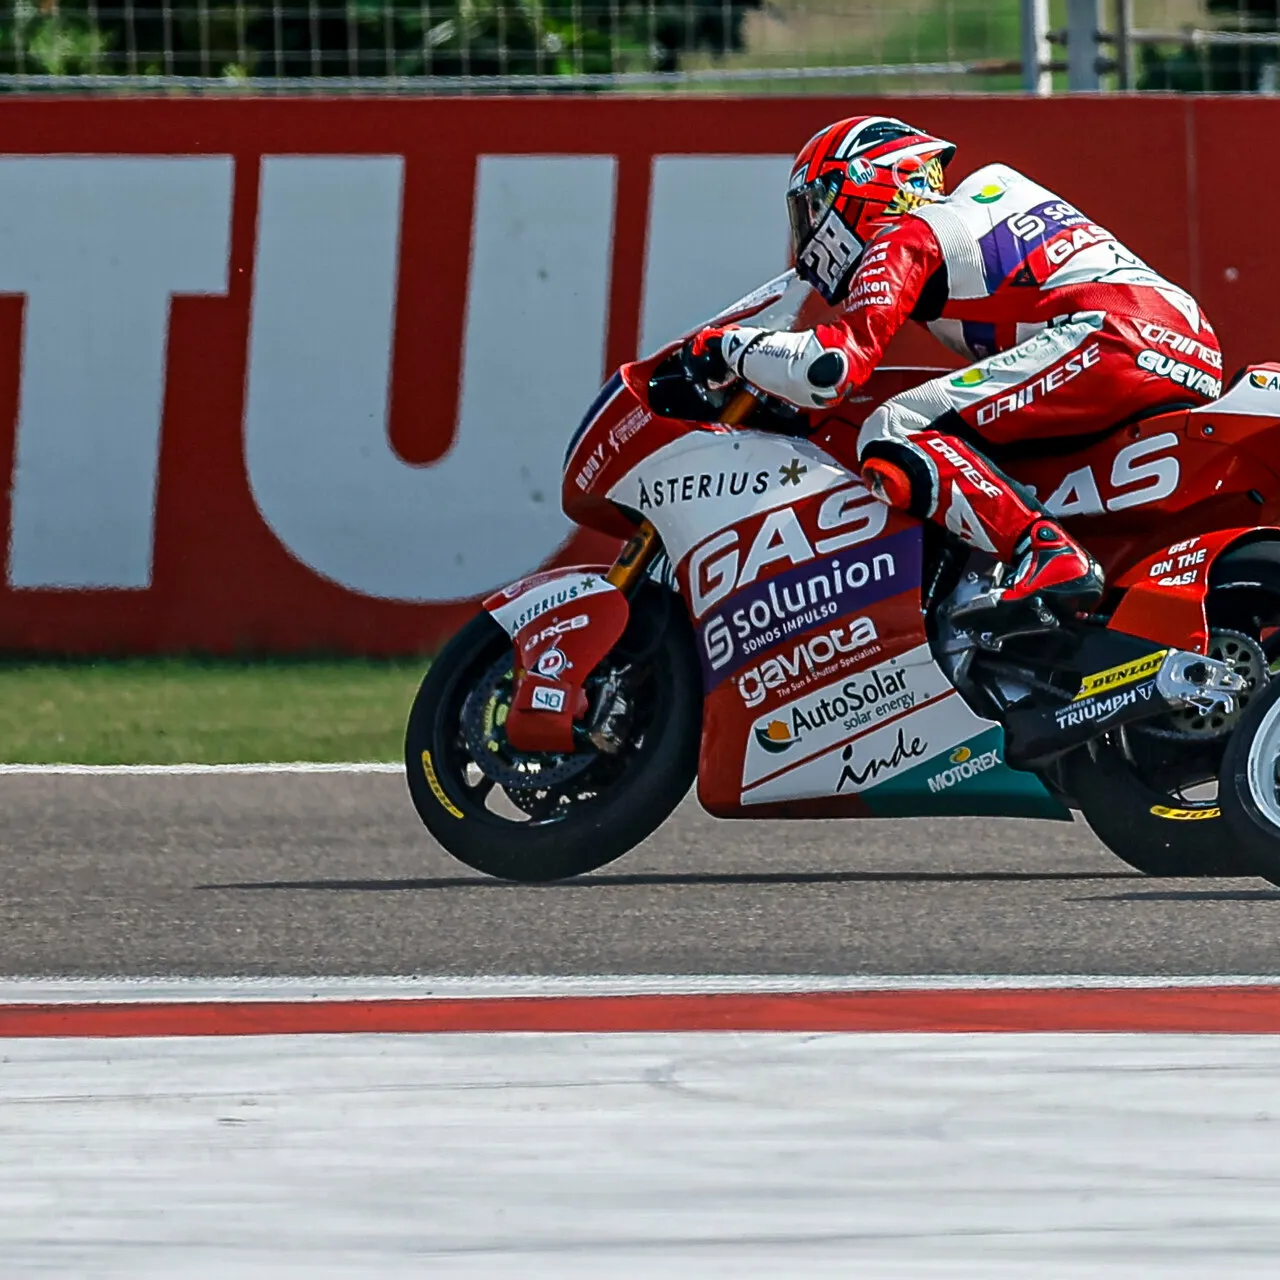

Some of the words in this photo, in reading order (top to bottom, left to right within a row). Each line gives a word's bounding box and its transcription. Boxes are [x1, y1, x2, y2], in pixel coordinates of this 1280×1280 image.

[977, 342, 1101, 426] DAINESE
[639, 470, 770, 510] ASTERIUS
[927, 438, 1004, 499] DAINESE
[688, 485, 890, 618] GAS
[1150, 558, 1174, 578] ON
[1177, 547, 1208, 570] THE
[1167, 536, 1201, 556] GET
[511, 585, 579, 634] ASTERIUS
[731, 552, 896, 640] solunion
[742, 626, 782, 656] SOMOS
[782, 601, 838, 635] IMPULSO
[791, 667, 909, 738] AutoSolar
[843, 712, 873, 732] solar
[875, 690, 916, 718] energy
[1056, 689, 1137, 729] TRIUMPH
[927, 748, 1003, 794] MOTOREX
